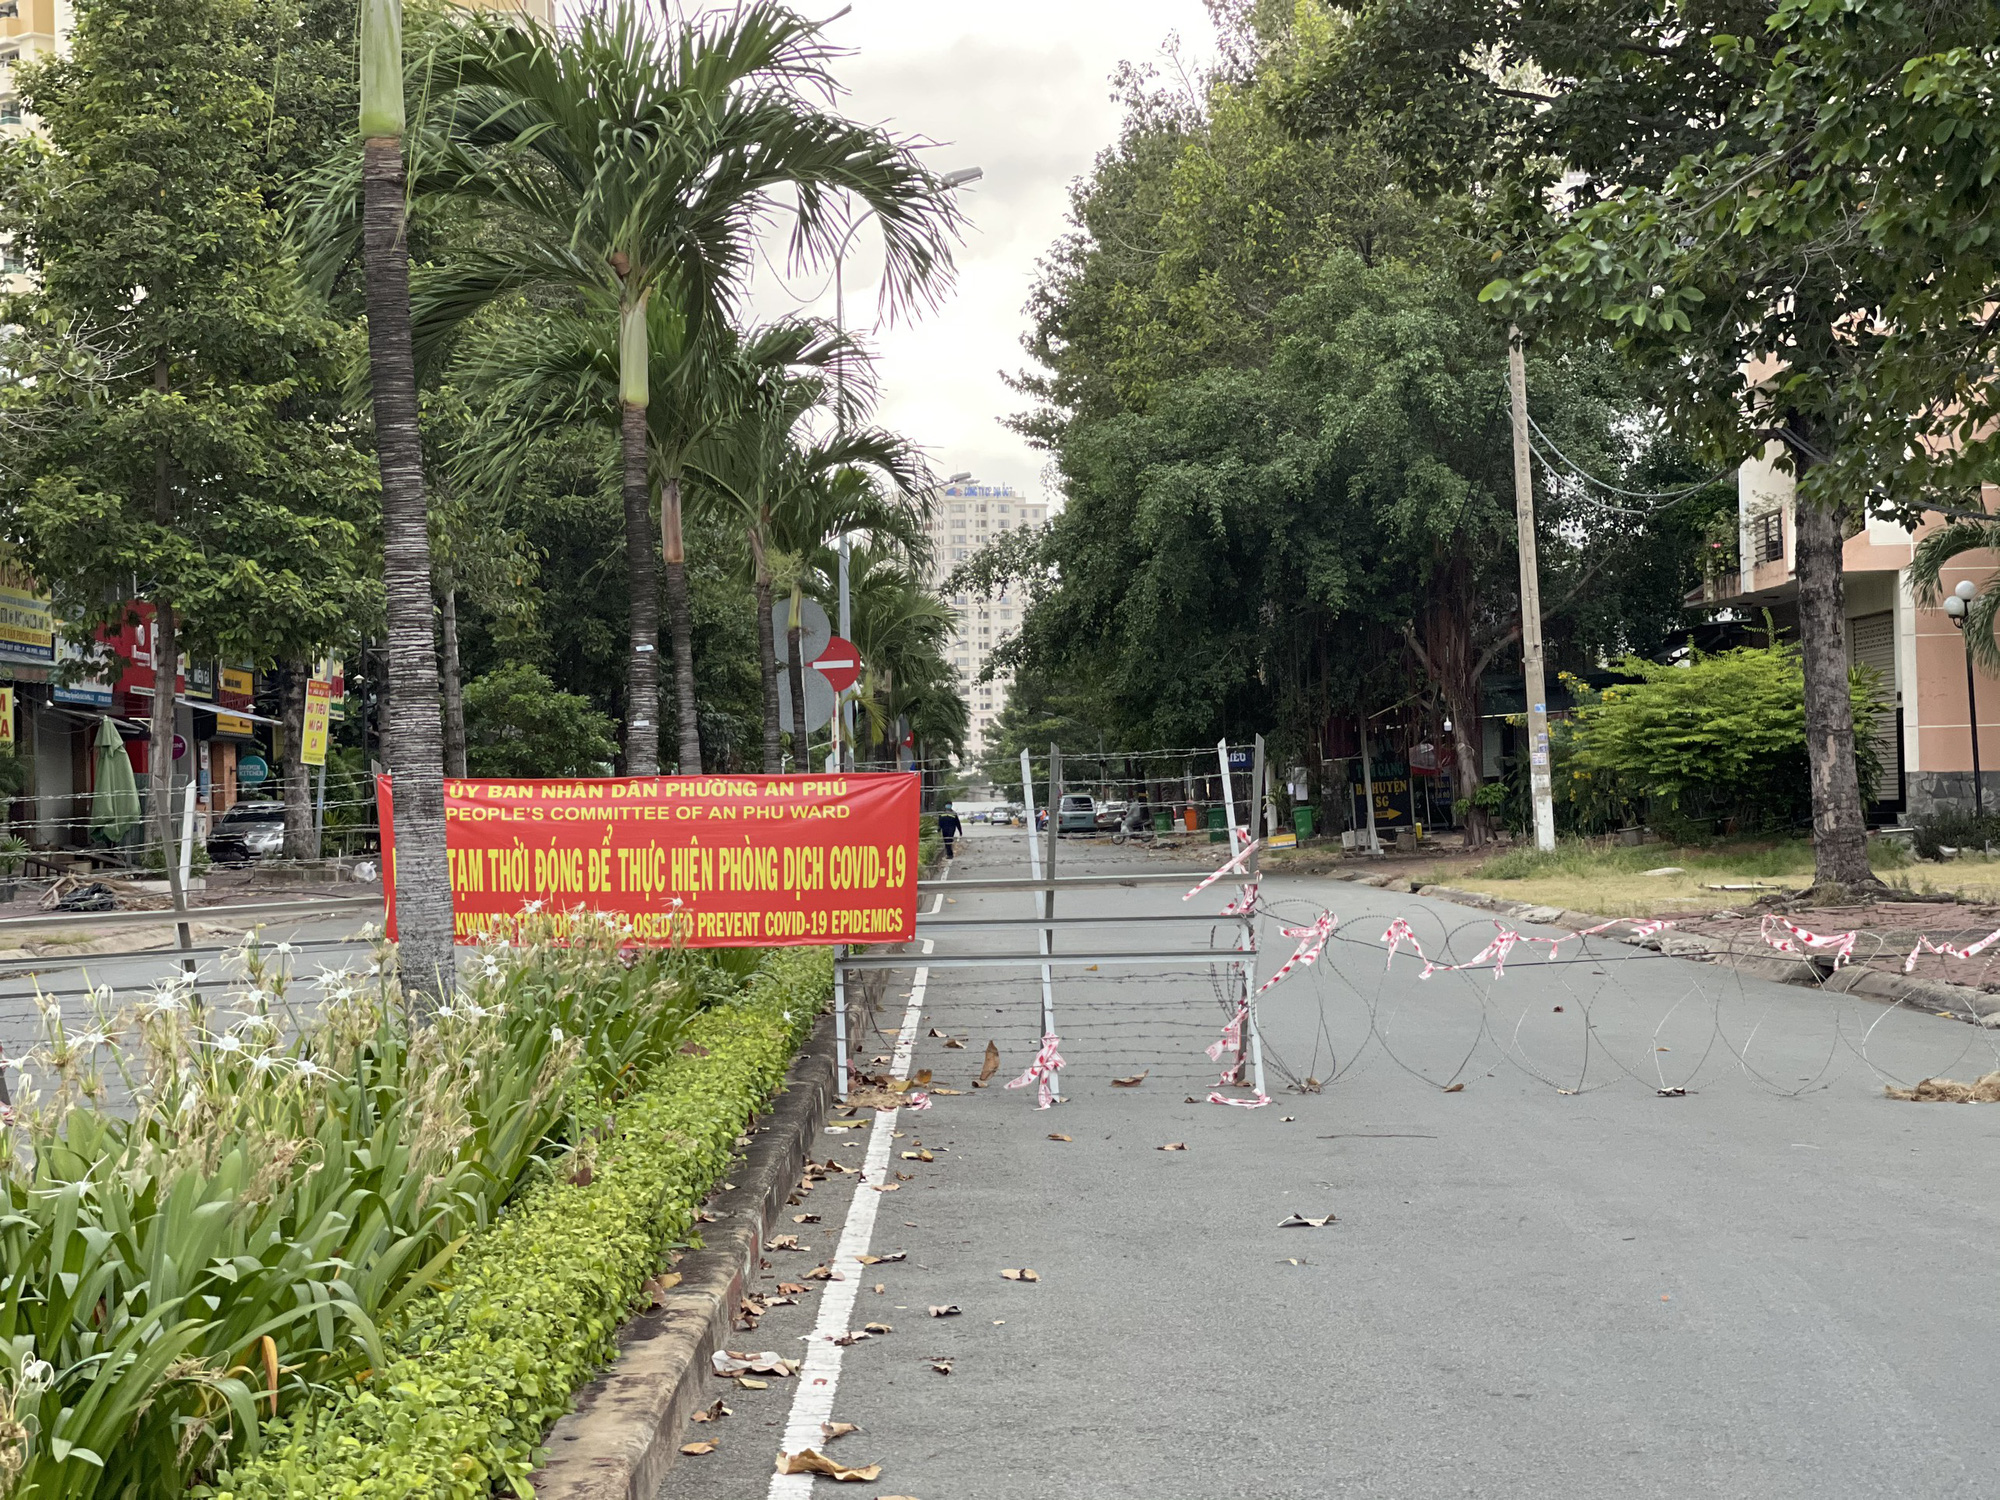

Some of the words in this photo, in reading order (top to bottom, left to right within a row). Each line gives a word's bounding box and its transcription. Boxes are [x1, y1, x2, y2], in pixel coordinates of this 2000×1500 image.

[449, 780, 480, 799] ỦY
[488, 785, 534, 799] BAN
[541, 782, 604, 799] NHÂN
[611, 780, 658, 798] DÂN
[665, 778, 758, 798] PHƯỜNG
[764, 781, 795, 797] AN
[802, 777, 847, 796] PHÚ
[550, 806, 670, 821] COMMITTEE
[675, 806, 703, 820] OF
[708, 805, 737, 820] AN
[743, 805, 785, 819] PHU
[790, 804, 850, 819] WARD
[1375, 795, 1390, 808] SG
[447, 848, 484, 901] TẠM
[487, 836, 529, 893] THỜI
[534, 836, 583, 893] ĐÓNG
[588, 823, 612, 892] ĐỂ
[617, 839, 666, 901] THỰC
[671, 835, 713, 901] HIỆN
[719, 834, 778, 892] PHÒNG
[783, 845, 824, 901] DỊCH
[829, 844, 907, 891] COVID-19
[698, 911, 761, 937] PREVENT
[765, 909, 828, 937] COVID-19
[831, 907, 904, 935] EPIDEMICS
